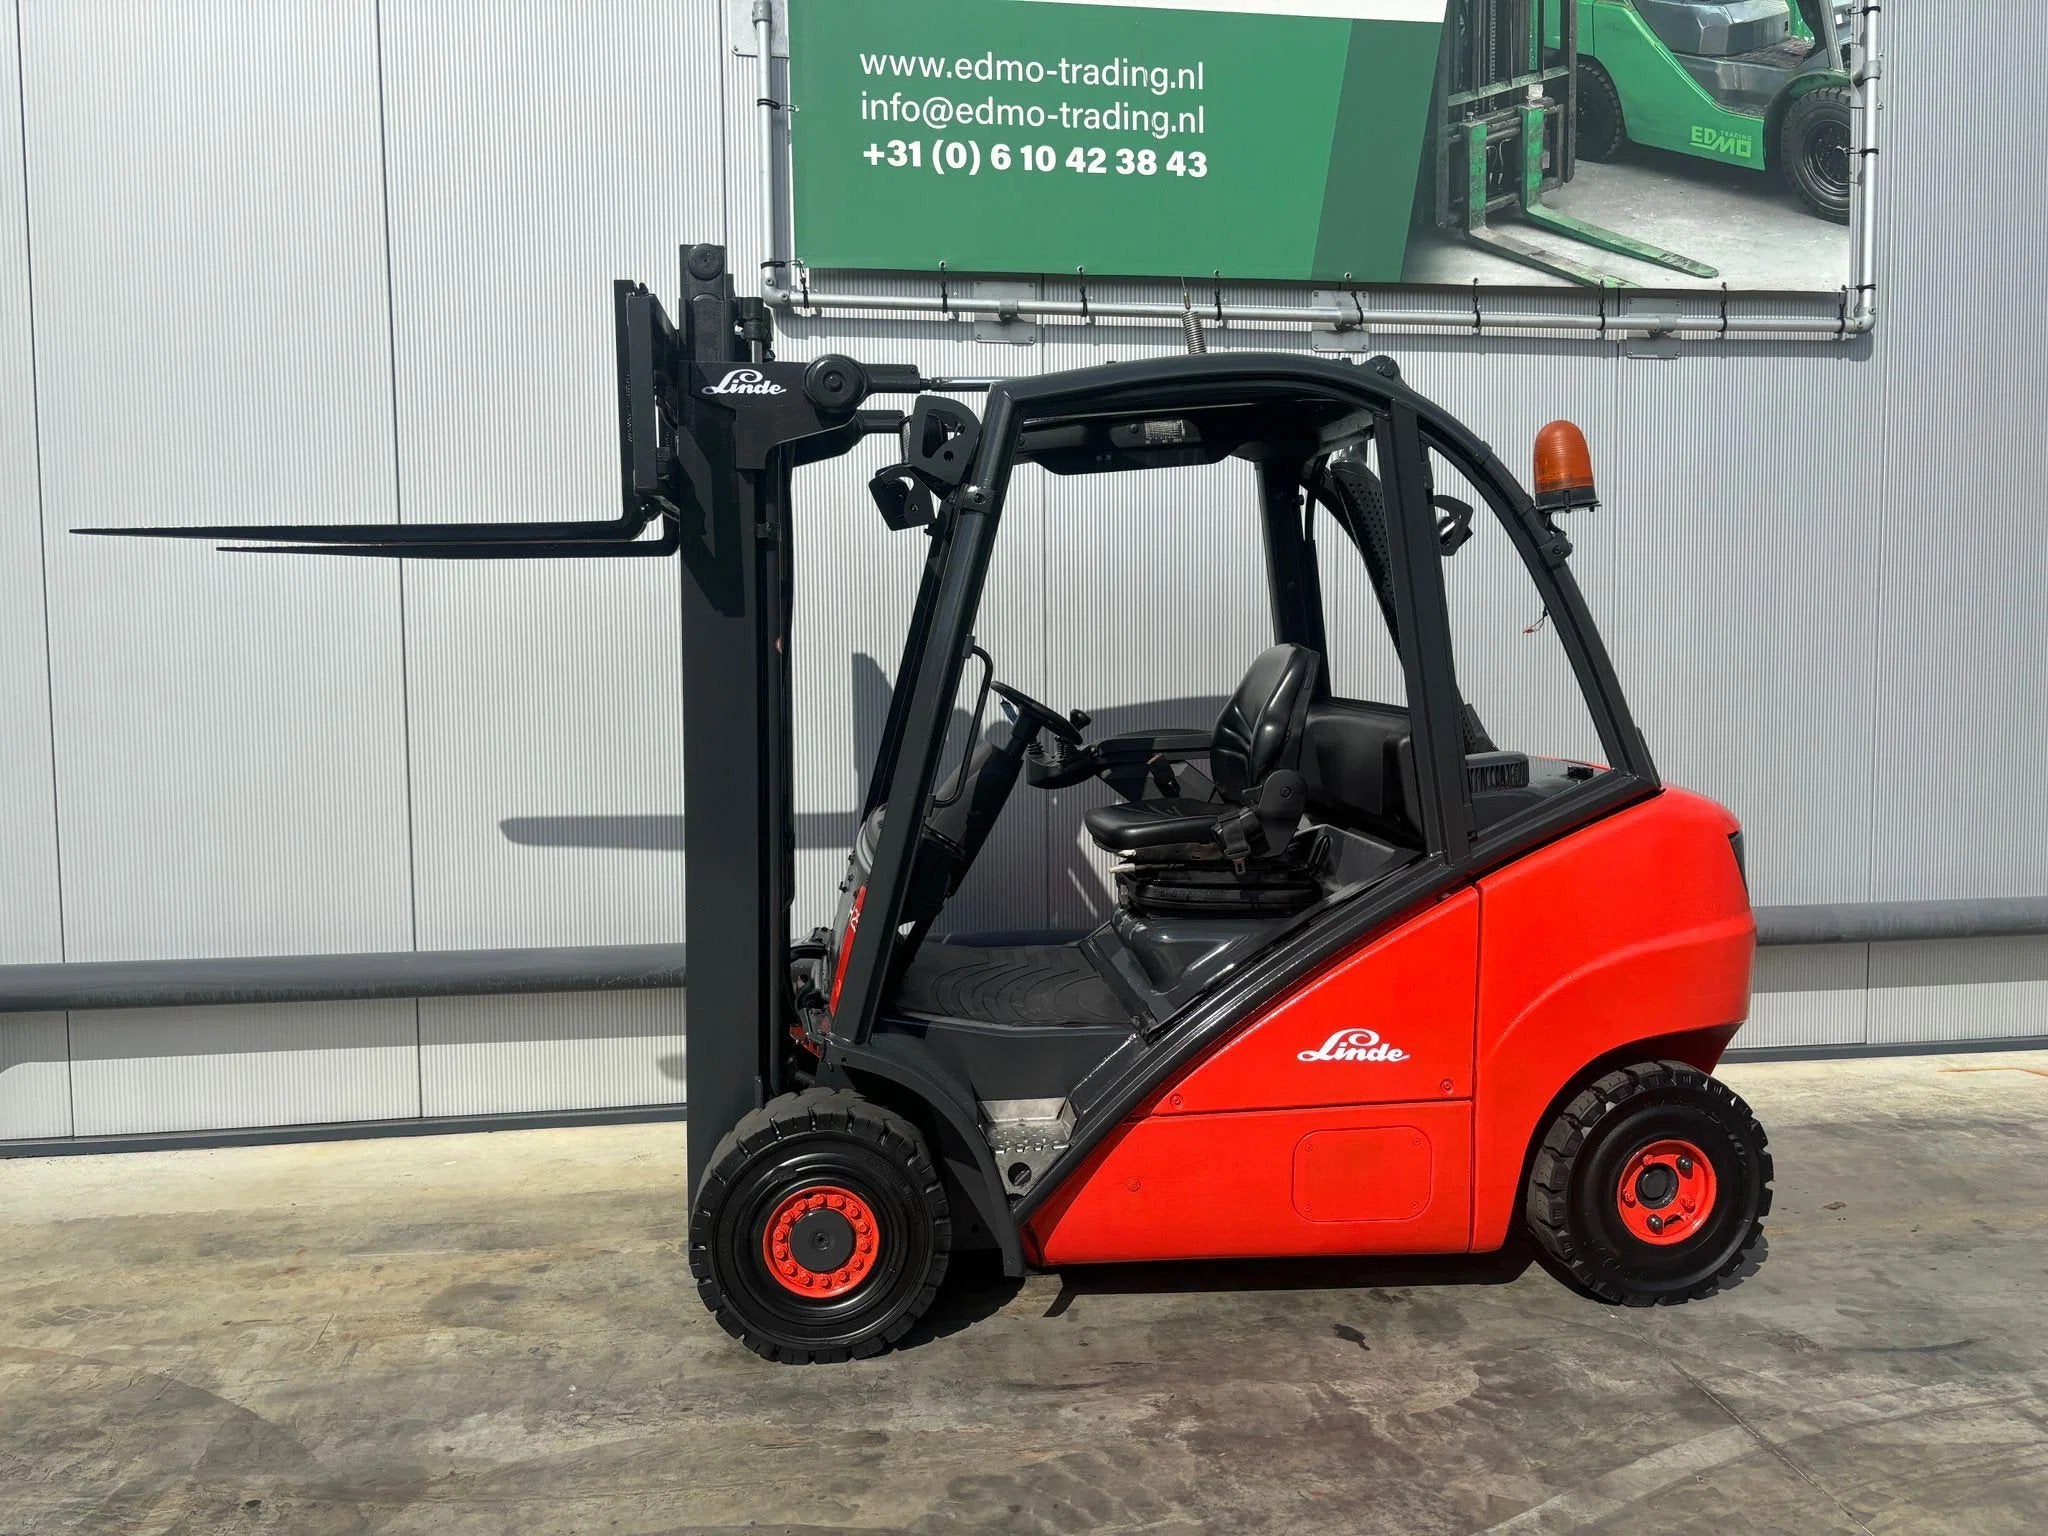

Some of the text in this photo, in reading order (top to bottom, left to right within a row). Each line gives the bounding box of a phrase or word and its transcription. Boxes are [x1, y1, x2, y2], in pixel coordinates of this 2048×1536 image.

[859, 51, 1204, 96] www.edmo-trading.nl
[860, 92, 1205, 140] info@edmo-trading.nl
[1690, 125, 1752, 158] EDMO
[1720, 130, 1752, 141] TRADING
[862, 139, 1208, 178] +31 (0) 6 10 42 38 43
[701, 368, 787, 394] Linde
[1297, 1028, 1410, 1062] Linde
